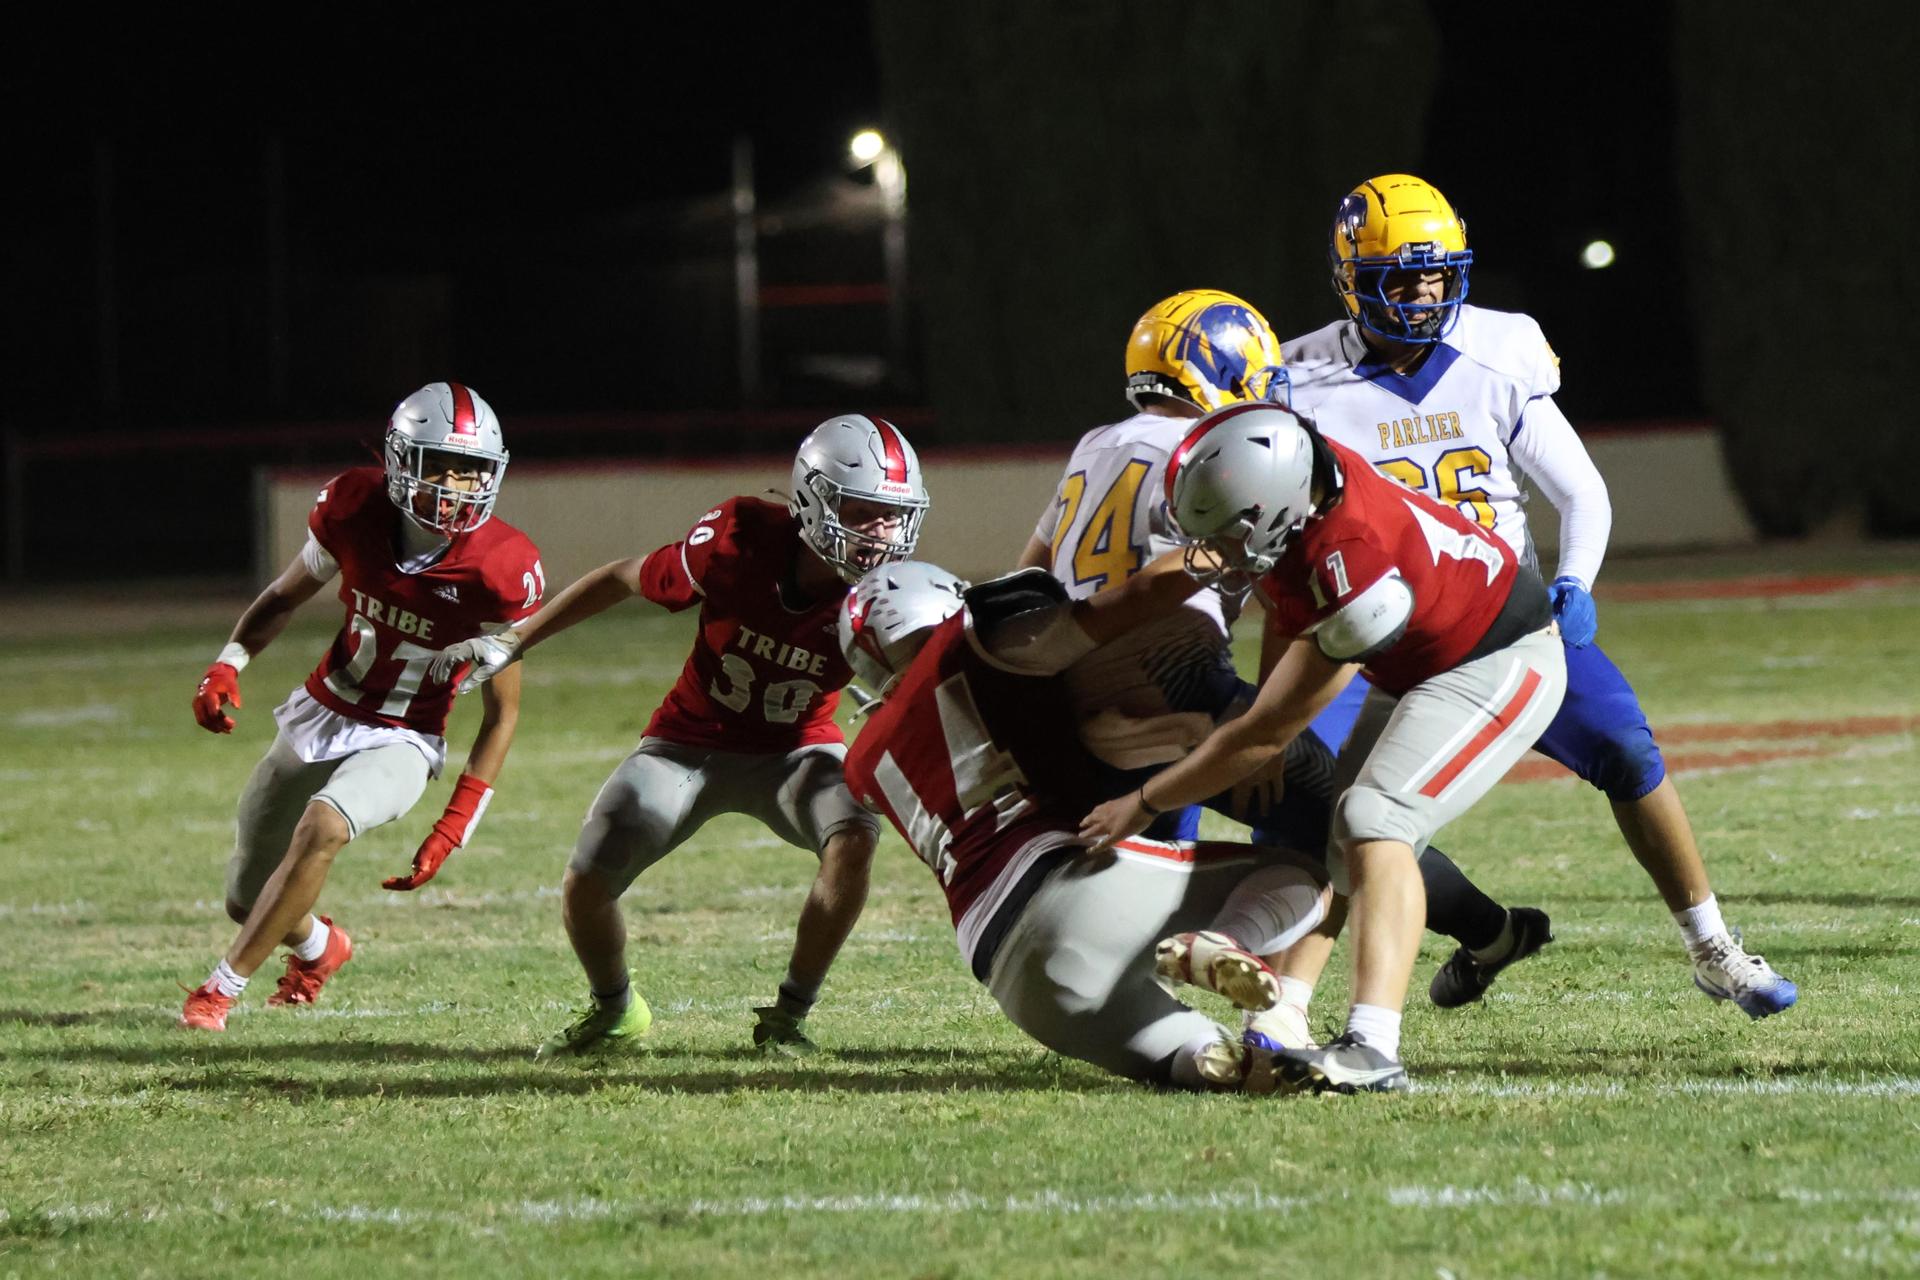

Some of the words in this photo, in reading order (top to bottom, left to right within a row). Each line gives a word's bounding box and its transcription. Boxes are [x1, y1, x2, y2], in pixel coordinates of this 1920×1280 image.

[1376, 411, 1464, 449] PARLIER
[351, 588, 434, 641] TRIBE
[322, 612, 441, 718] 21
[737, 624, 828, 677] TRIBE
[709, 652, 823, 724] 30
